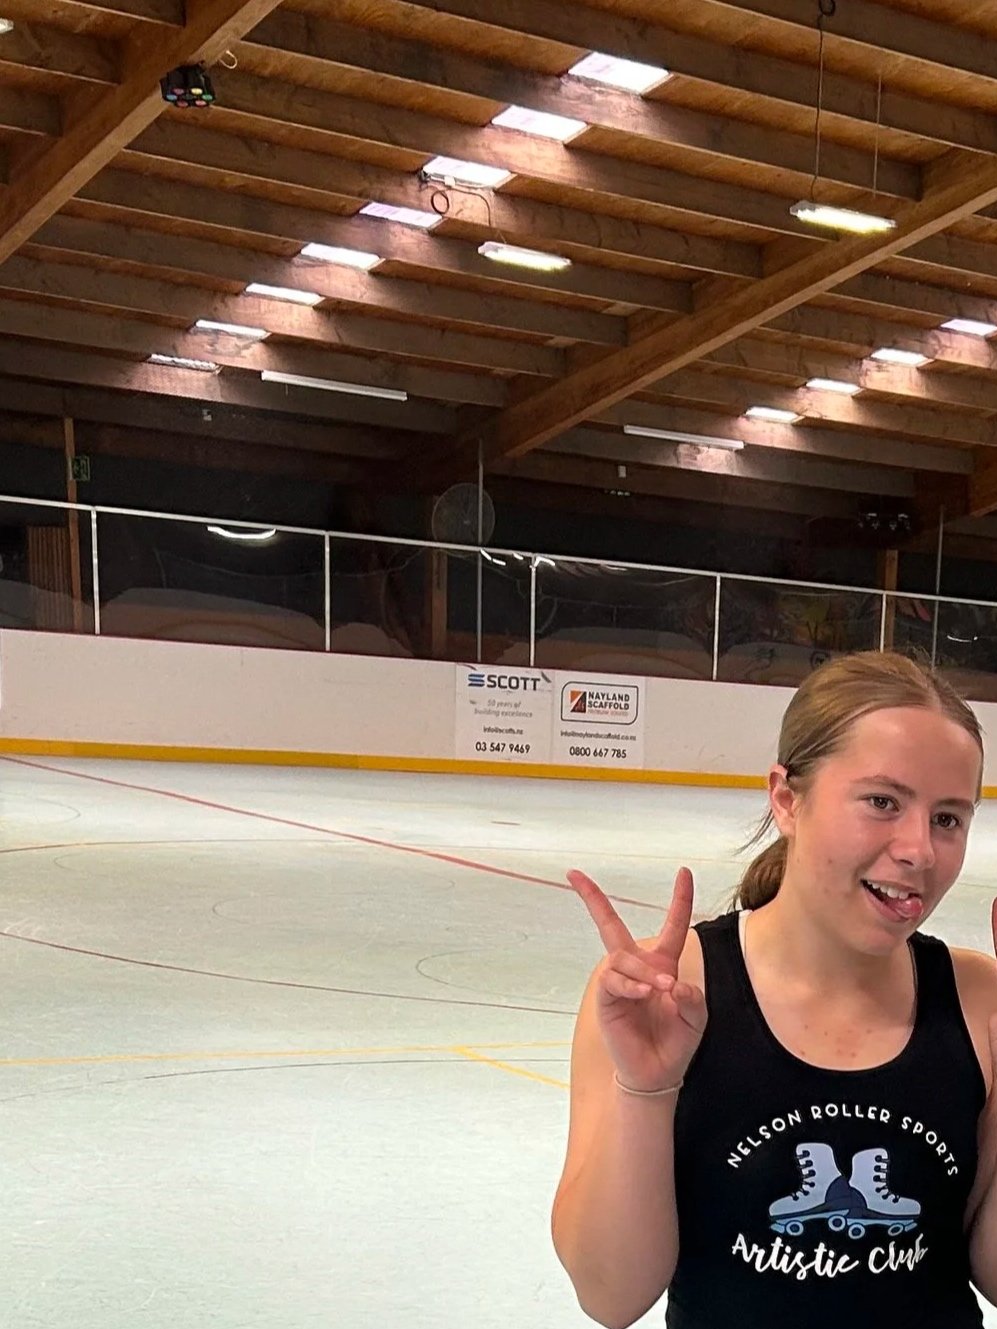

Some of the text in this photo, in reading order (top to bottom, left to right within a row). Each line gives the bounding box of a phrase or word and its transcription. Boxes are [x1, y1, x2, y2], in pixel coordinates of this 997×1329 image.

[486, 674, 541, 691] SCOTT
[588, 691, 630, 702] NAYLAND
[587, 700, 630, 711] SCAFFOLD
[475, 742, 531, 754] 03 547 9469
[569, 745, 627, 759] 0800 667 785
[727, 1103, 959, 1176] NELSON ROLLER SPORTS
[732, 1233, 929, 1281] Artistic Club
